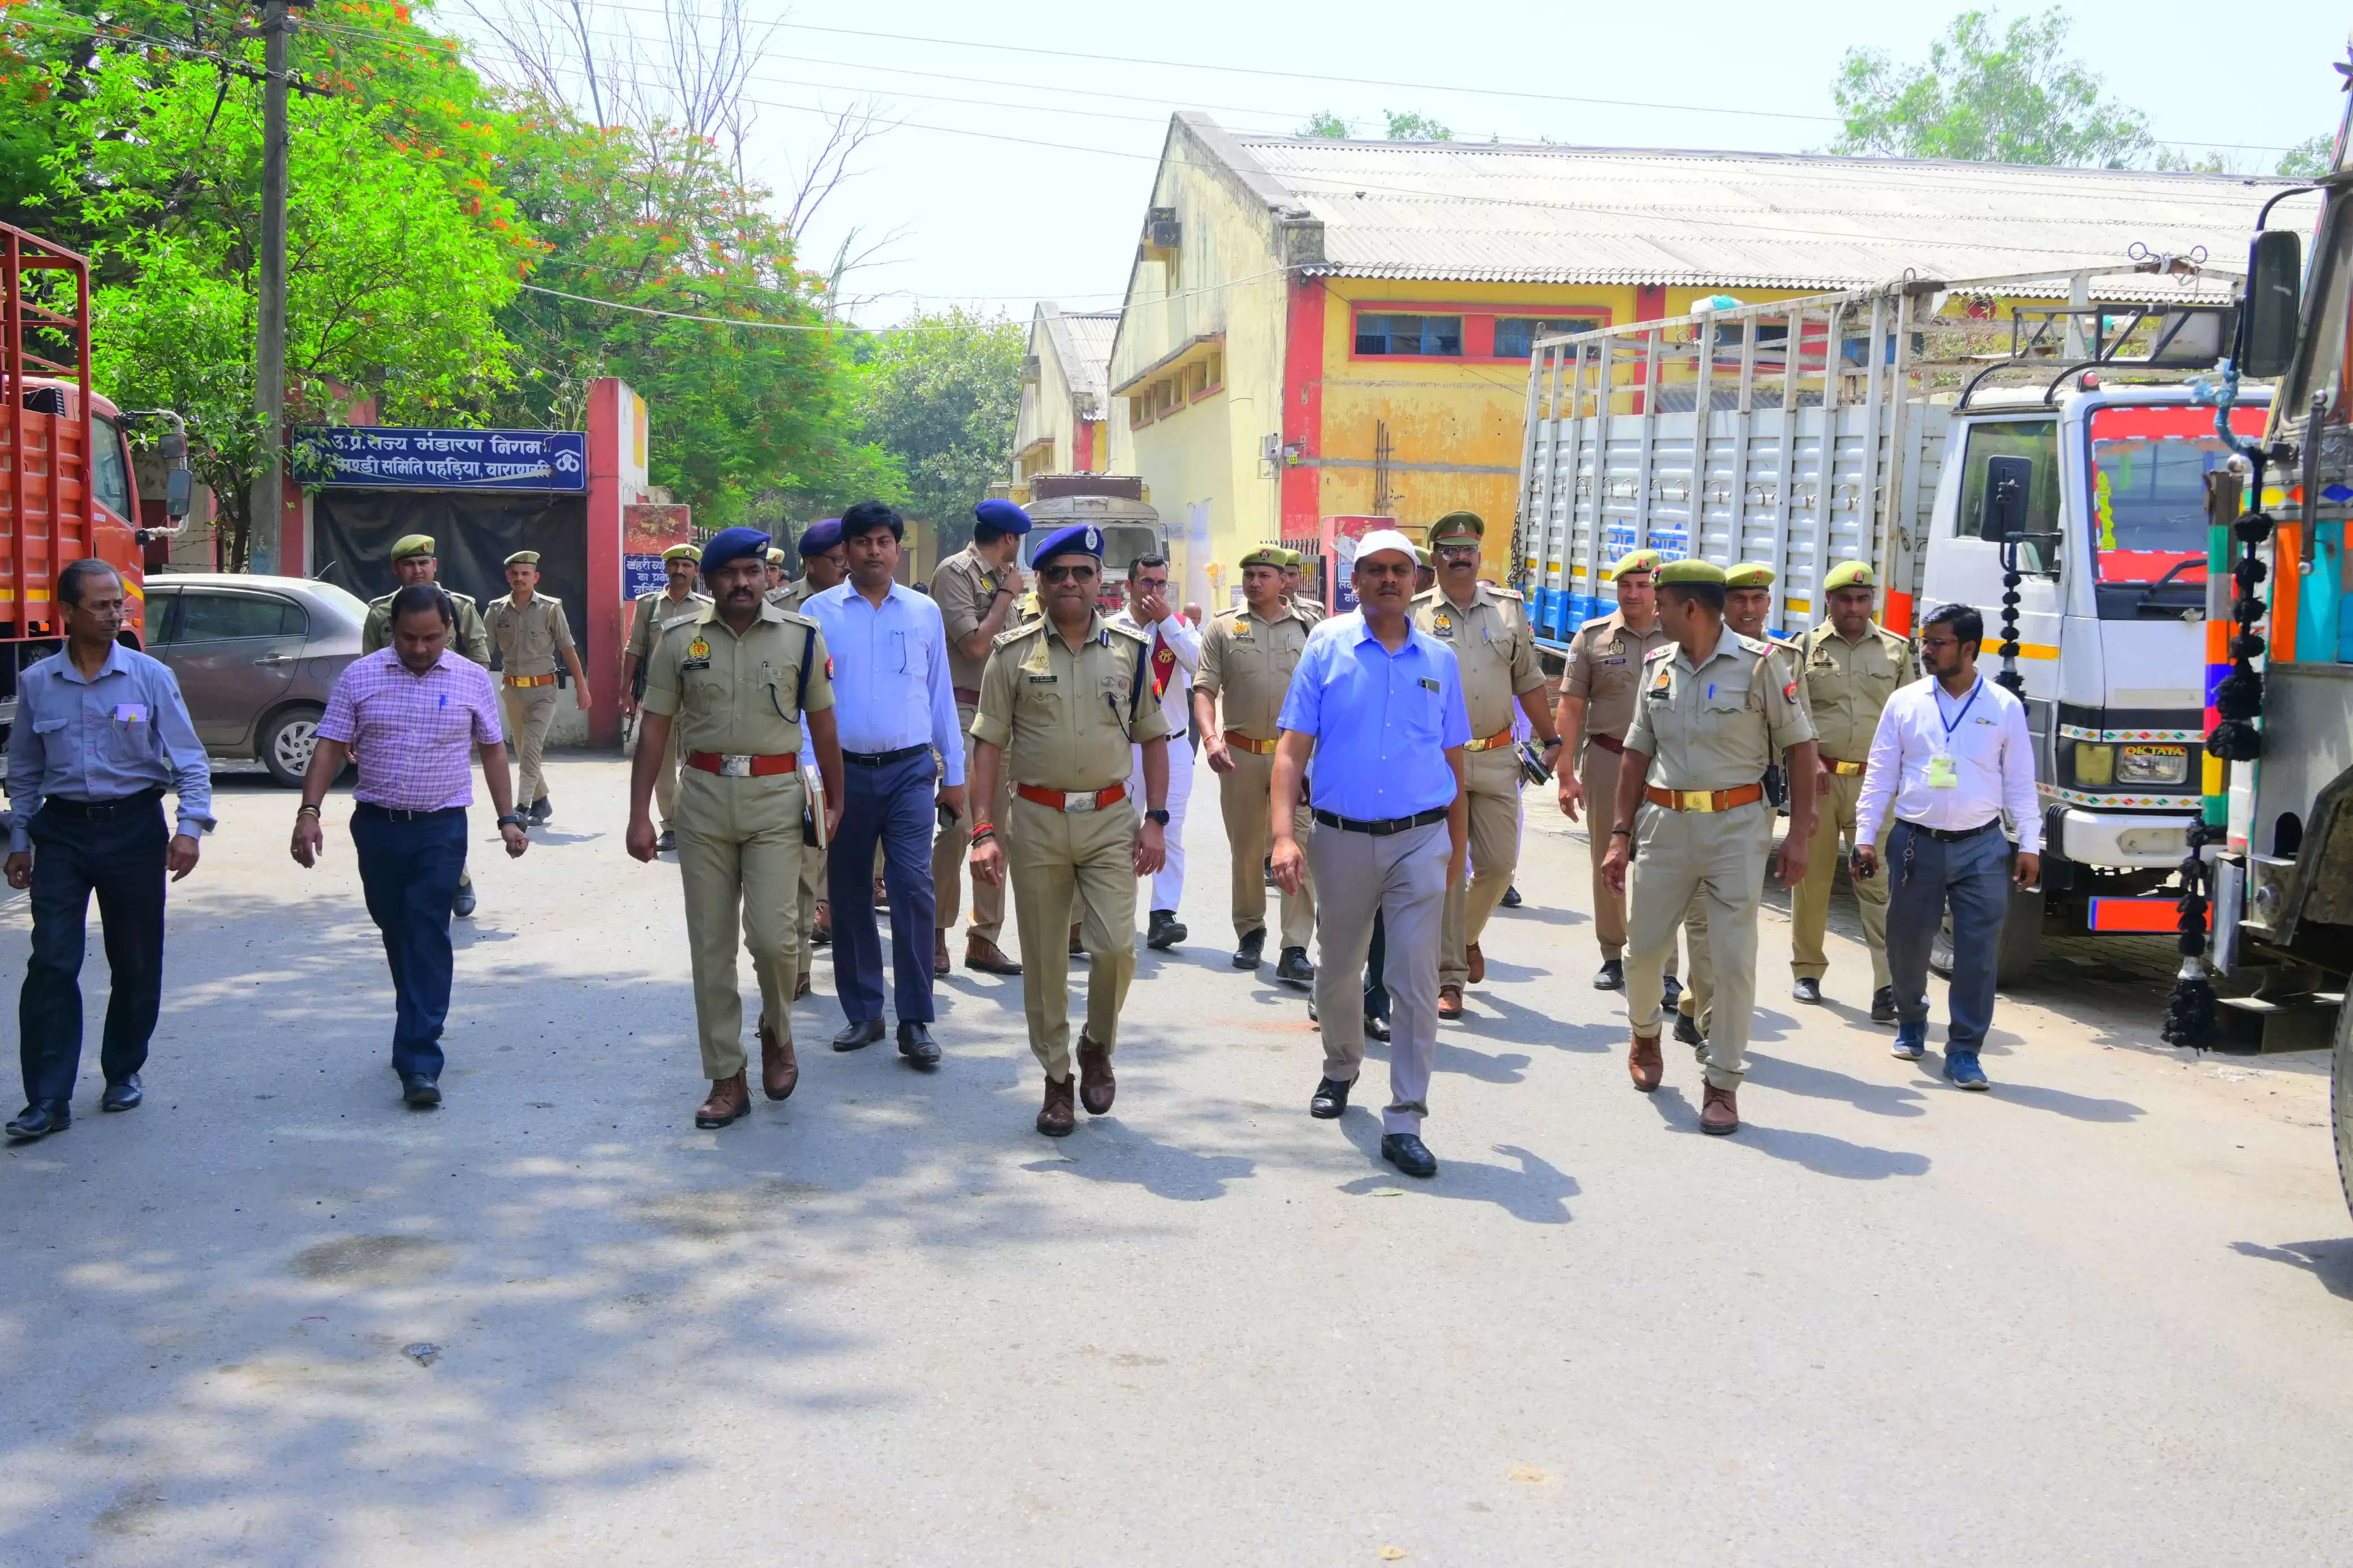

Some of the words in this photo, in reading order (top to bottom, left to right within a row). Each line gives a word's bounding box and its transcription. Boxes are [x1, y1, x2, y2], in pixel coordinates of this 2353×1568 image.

[368, 437, 408, 451] राज्य
[413, 431, 485, 452] भंडारण
[489, 435, 542, 455] निगम
[381, 456, 424, 475] समिति
[637, 573, 649, 581] का
[2126, 746, 2148, 755] OK
[2149, 746, 2183, 755] TATA
